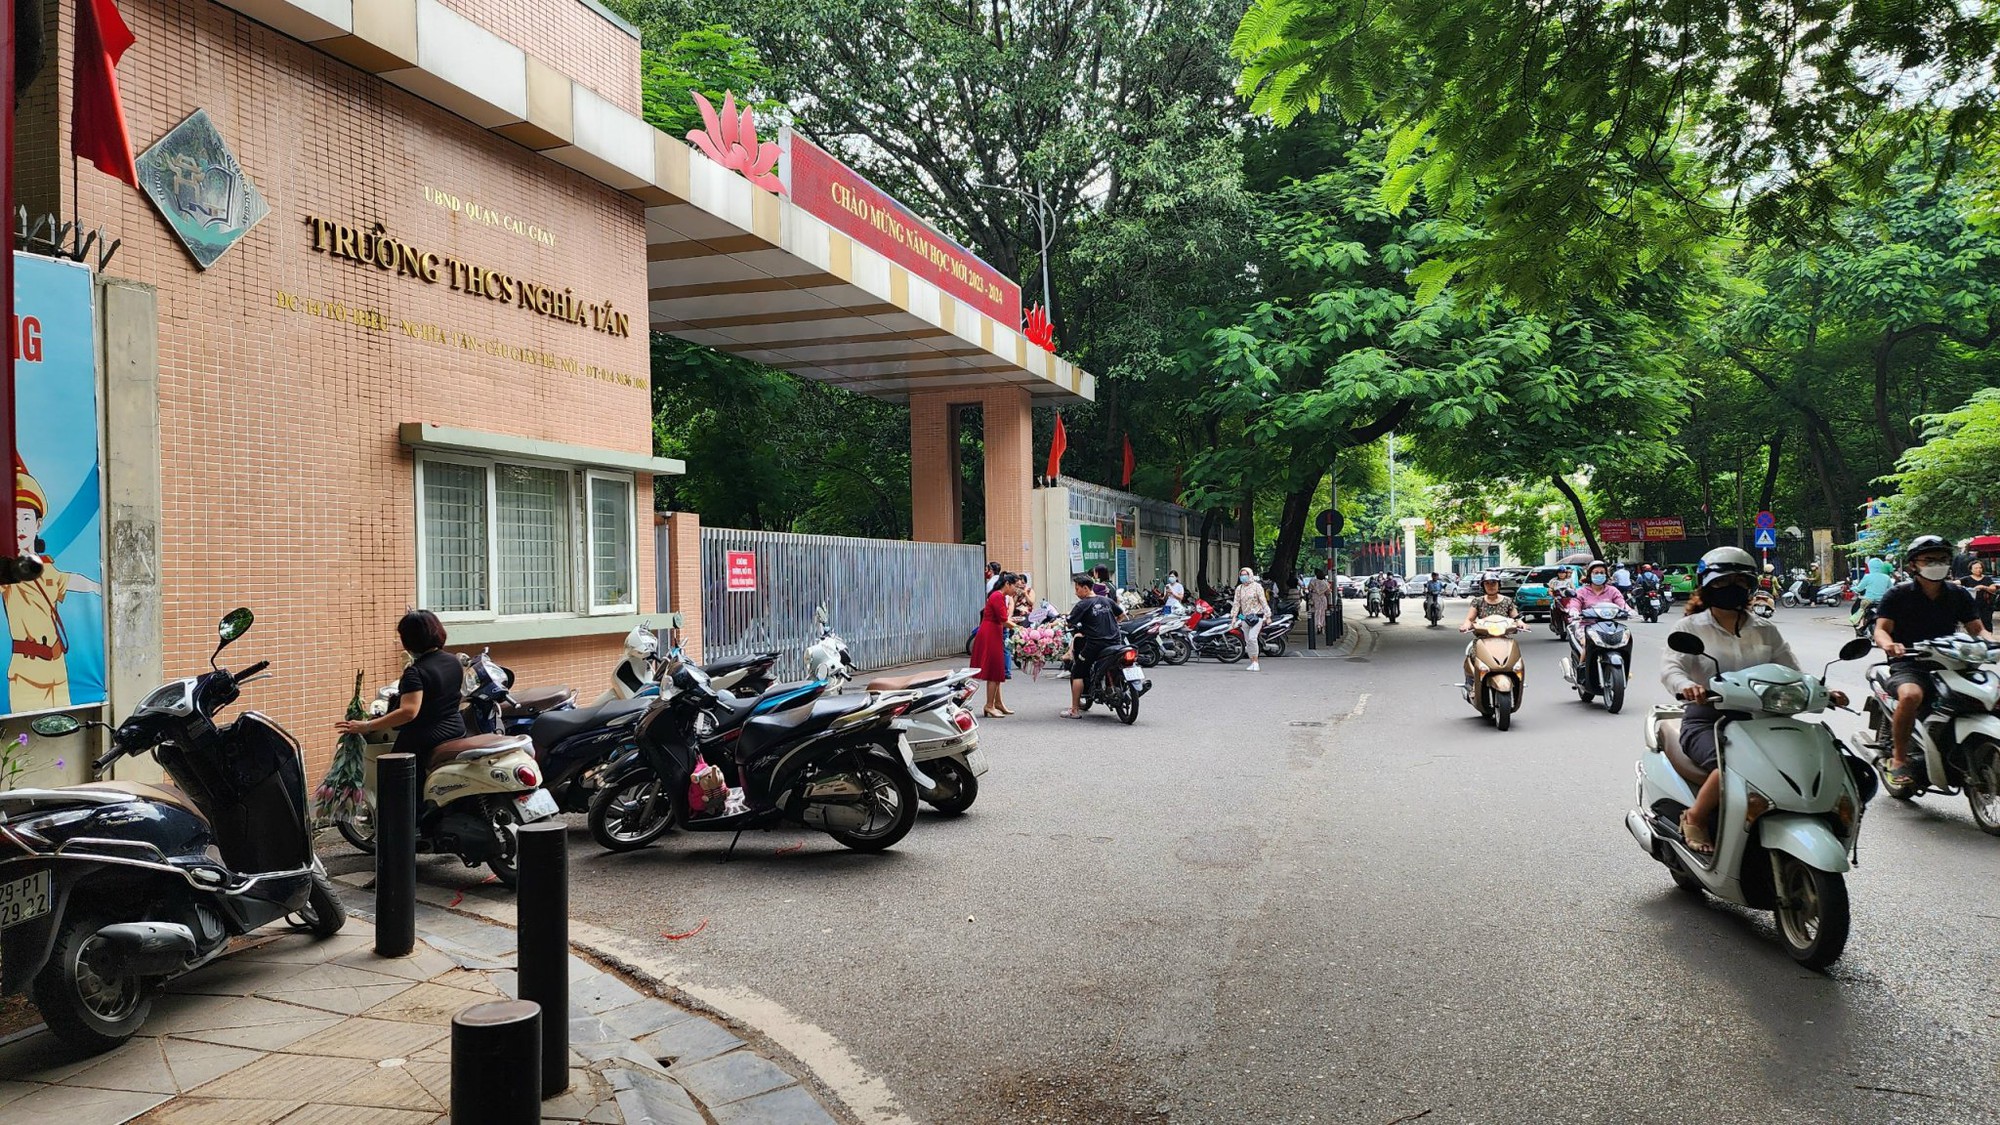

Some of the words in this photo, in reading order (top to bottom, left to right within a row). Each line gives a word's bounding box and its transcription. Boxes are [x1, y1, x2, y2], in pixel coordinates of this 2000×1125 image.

[424, 185, 460, 212] UBND
[831, 181, 868, 221] CHÀO
[870, 204, 904, 243] MỪNG
[906, 228, 929, 259] NĂM
[930, 243, 950, 273] HỌC
[951, 257, 968, 284] MỚI
[306, 215, 441, 284] TRƯỜNG
[446, 256, 514, 304] THCS
[517, 280, 588, 328] NGHĨA
[590, 300, 630, 339] TÂN
